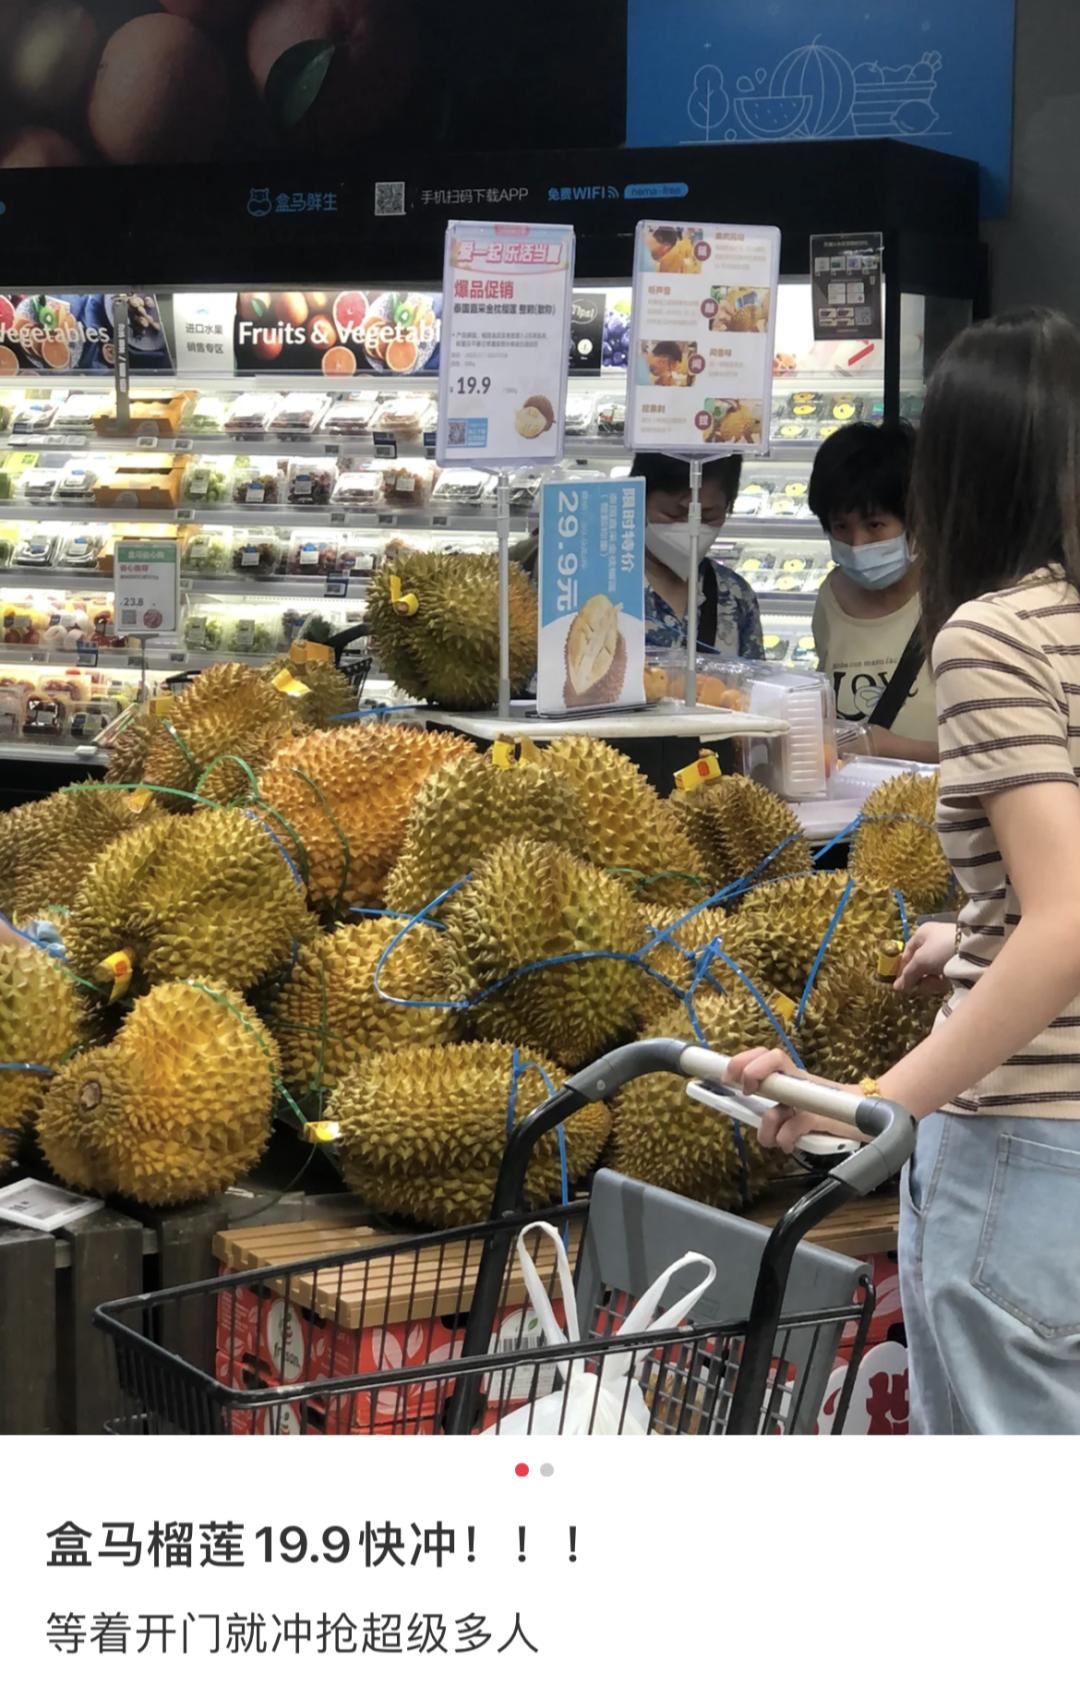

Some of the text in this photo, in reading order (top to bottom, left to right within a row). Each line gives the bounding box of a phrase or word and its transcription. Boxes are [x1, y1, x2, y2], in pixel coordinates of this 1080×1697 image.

[275, 192, 338, 212] 盒马鲜生
[421, 188, 529, 205] 手机扫码下载APP
[548, 187, 605, 201] 免费WIFI
[454, 280, 514, 299] 爆品促销
[0, 323, 110, 348] egetables
[239, 322, 306, 345] Fruits
[310, 321, 329, 344] &
[187, 342, 224, 355] 销售专区
[457, 376, 491, 394] 19.9
[621, 488, 635, 572] 限时特价
[556, 490, 579, 611] 29.9元
